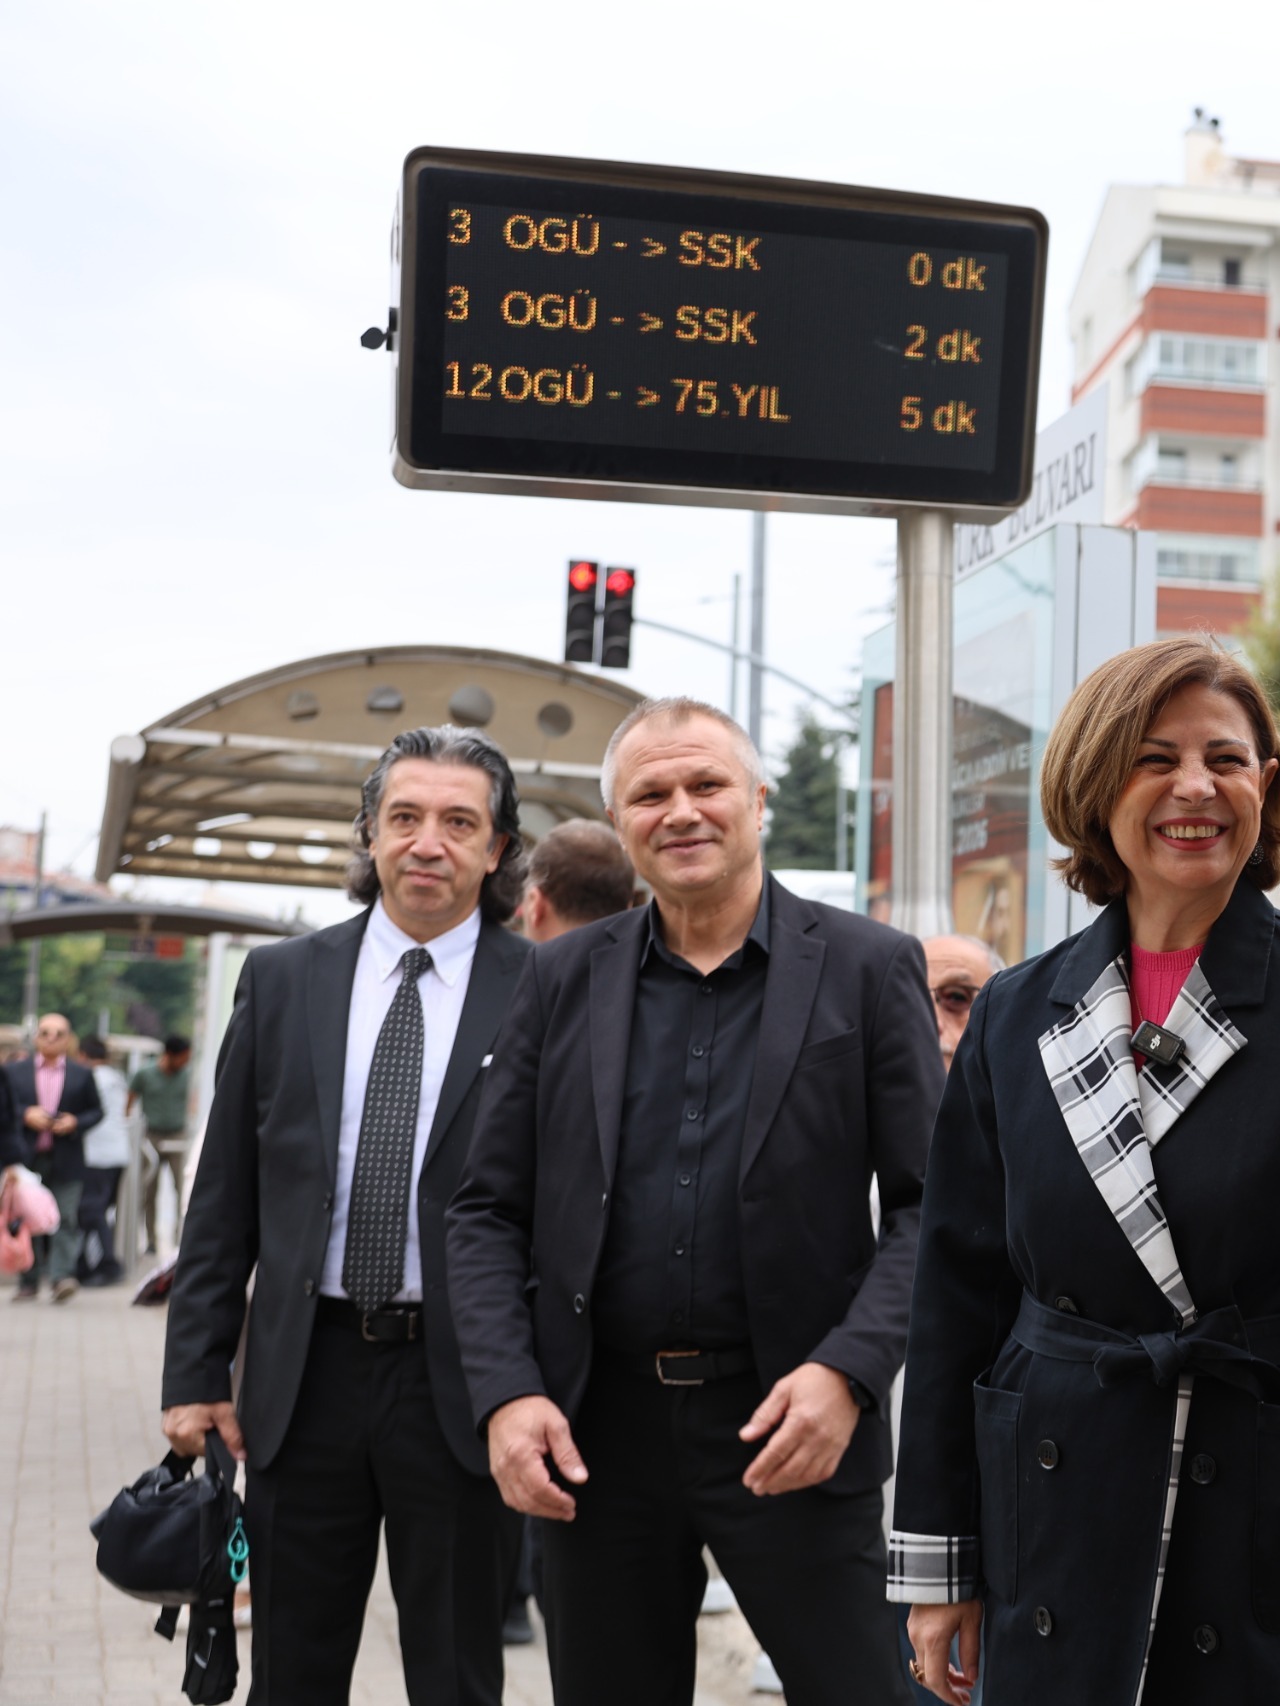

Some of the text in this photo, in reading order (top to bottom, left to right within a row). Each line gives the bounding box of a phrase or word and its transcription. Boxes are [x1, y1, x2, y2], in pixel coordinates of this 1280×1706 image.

[448, 208, 986, 292] 3 OGÜ SSK 0 dk
[447, 285, 981, 363] 3 OGÜ SSK 2 dk
[901, 396, 923, 431] 5
[933, 401, 977, 434] dk
